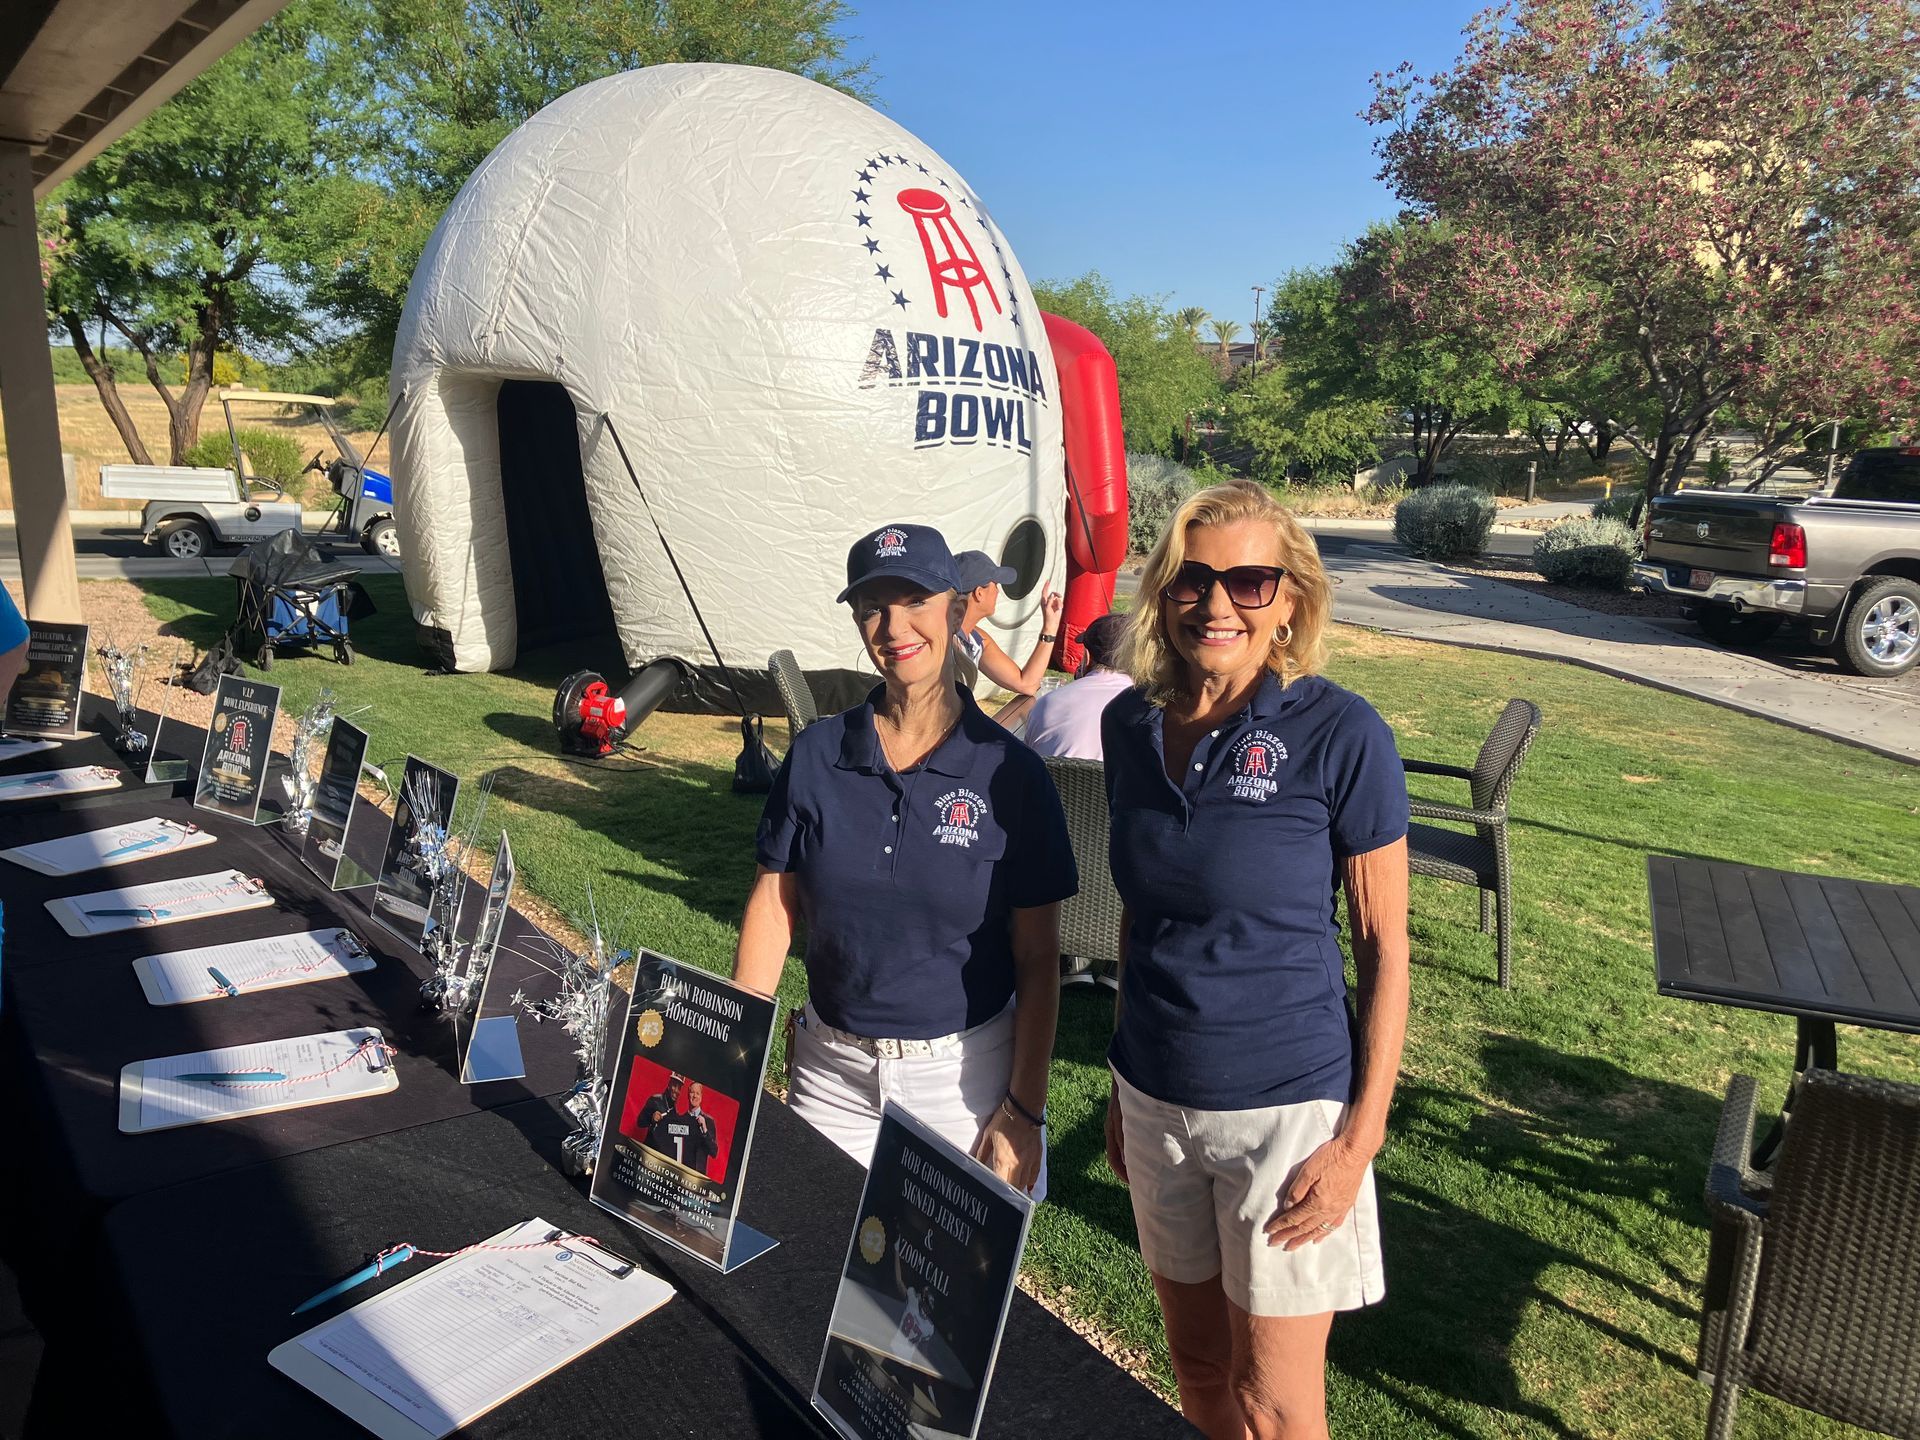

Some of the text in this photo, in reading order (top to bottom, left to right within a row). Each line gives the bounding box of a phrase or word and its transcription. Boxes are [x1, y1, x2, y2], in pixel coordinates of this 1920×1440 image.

[857, 327, 1048, 404] ARIZONA
[914, 389, 1032, 448] BOWL
[875, 545, 907, 556] ARIZONA
[880, 550, 902, 558] BOWL
[222, 696, 269, 715] BOWL EXPERIENCE
[1253, 729, 1289, 760] Blazers
[216, 749, 251, 770] ARIZONA
[221, 761, 243, 775] BOWL
[1226, 775, 1278, 794] ARIZONA
[1232, 785, 1267, 802] BOWL
[933, 788, 988, 814] Blue Blazers
[932, 824, 979, 842] ARIZONA
[939, 834, 971, 848] BOWL
[691, 985, 744, 1022] ROBINSON
[643, 1021, 660, 1036] #3
[665, 1001, 731, 1043] HOMECOMING
[673, 1136, 683, 1164] 1
[618, 1145, 637, 1160] CATCH
[644, 1160, 680, 1181] HOMETOWN
[681, 1179, 698, 1191] HERO
[699, 1186, 707, 1196] IN
[618, 1164, 634, 1176] FOUR
[694, 1204, 713, 1219] SEATS
[637, 1164, 664, 1183] FALCONS
[665, 1179, 675, 1190] VS.
[677, 1185, 711, 1208] CARDINALS
[900, 1145, 989, 1227] ROB GRONKOWSKI
[636, 1183, 652, 1197] FARM
[653, 1191, 680, 1211] STADIUM
[687, 1211, 715, 1231] PARKING
[901, 1177, 973, 1247] SIGNED JERSEY
[923, 1228, 934, 1251] &
[899, 1237, 951, 1297] ZOOM CALL
[838, 1378, 883, 1427] CONVERSATION
[887, 1386, 908, 1411] TAMPA
